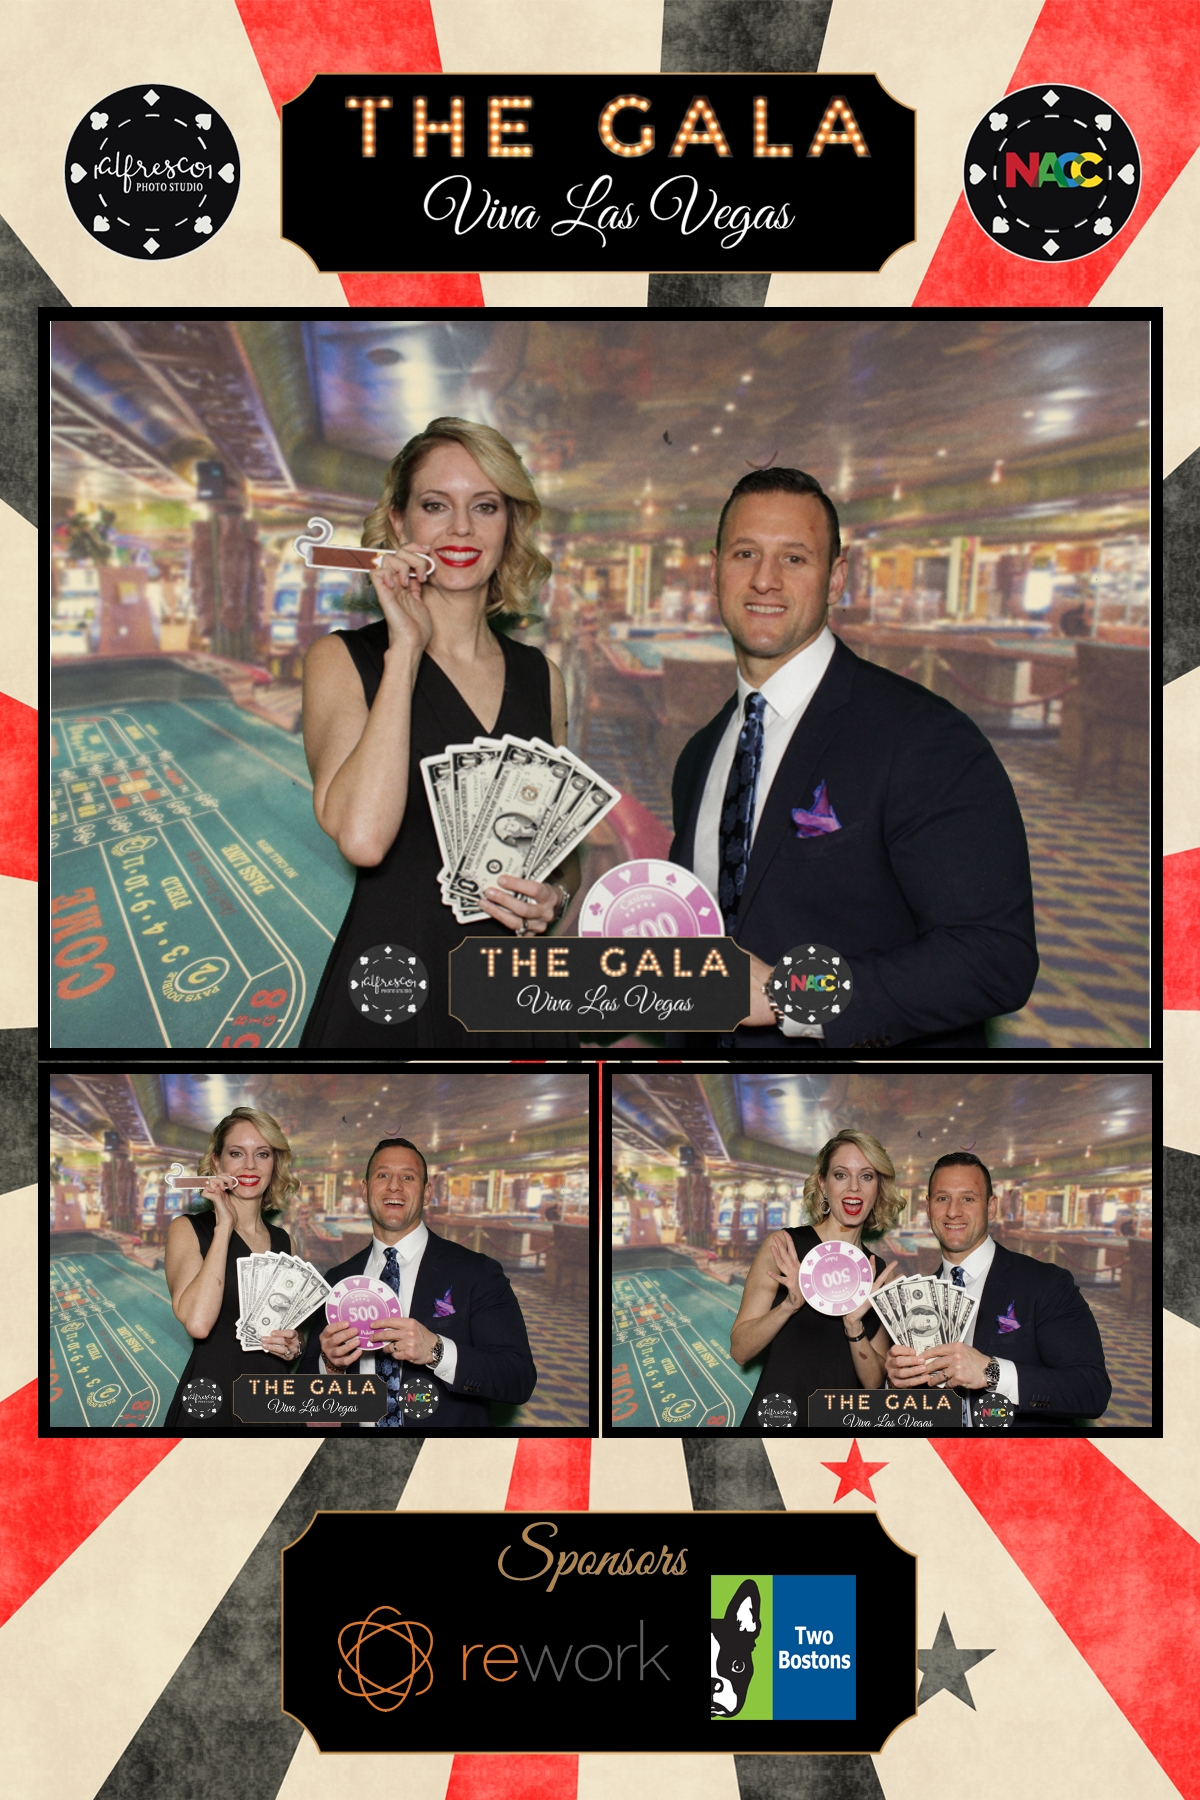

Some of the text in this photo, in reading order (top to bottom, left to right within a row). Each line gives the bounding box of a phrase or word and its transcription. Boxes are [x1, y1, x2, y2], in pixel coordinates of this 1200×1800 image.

[221, 843, 275, 896] PASS LINE
[161, 876, 192, 910] FIELD
[130, 900, 156, 913] 9
[142, 922, 168, 934] 4
[51, 887, 116, 999] COME
[161, 945, 190, 962] 3
[188, 962, 219, 984] 2
[250, 988, 288, 1008] 8
[822, 1267, 851, 1288] 500
[348, 1305, 379, 1323] 500
[612, 1363, 638, 1421] COME
[131, 1400, 150, 1410] 8
[706, 1416, 726, 1426] 8
